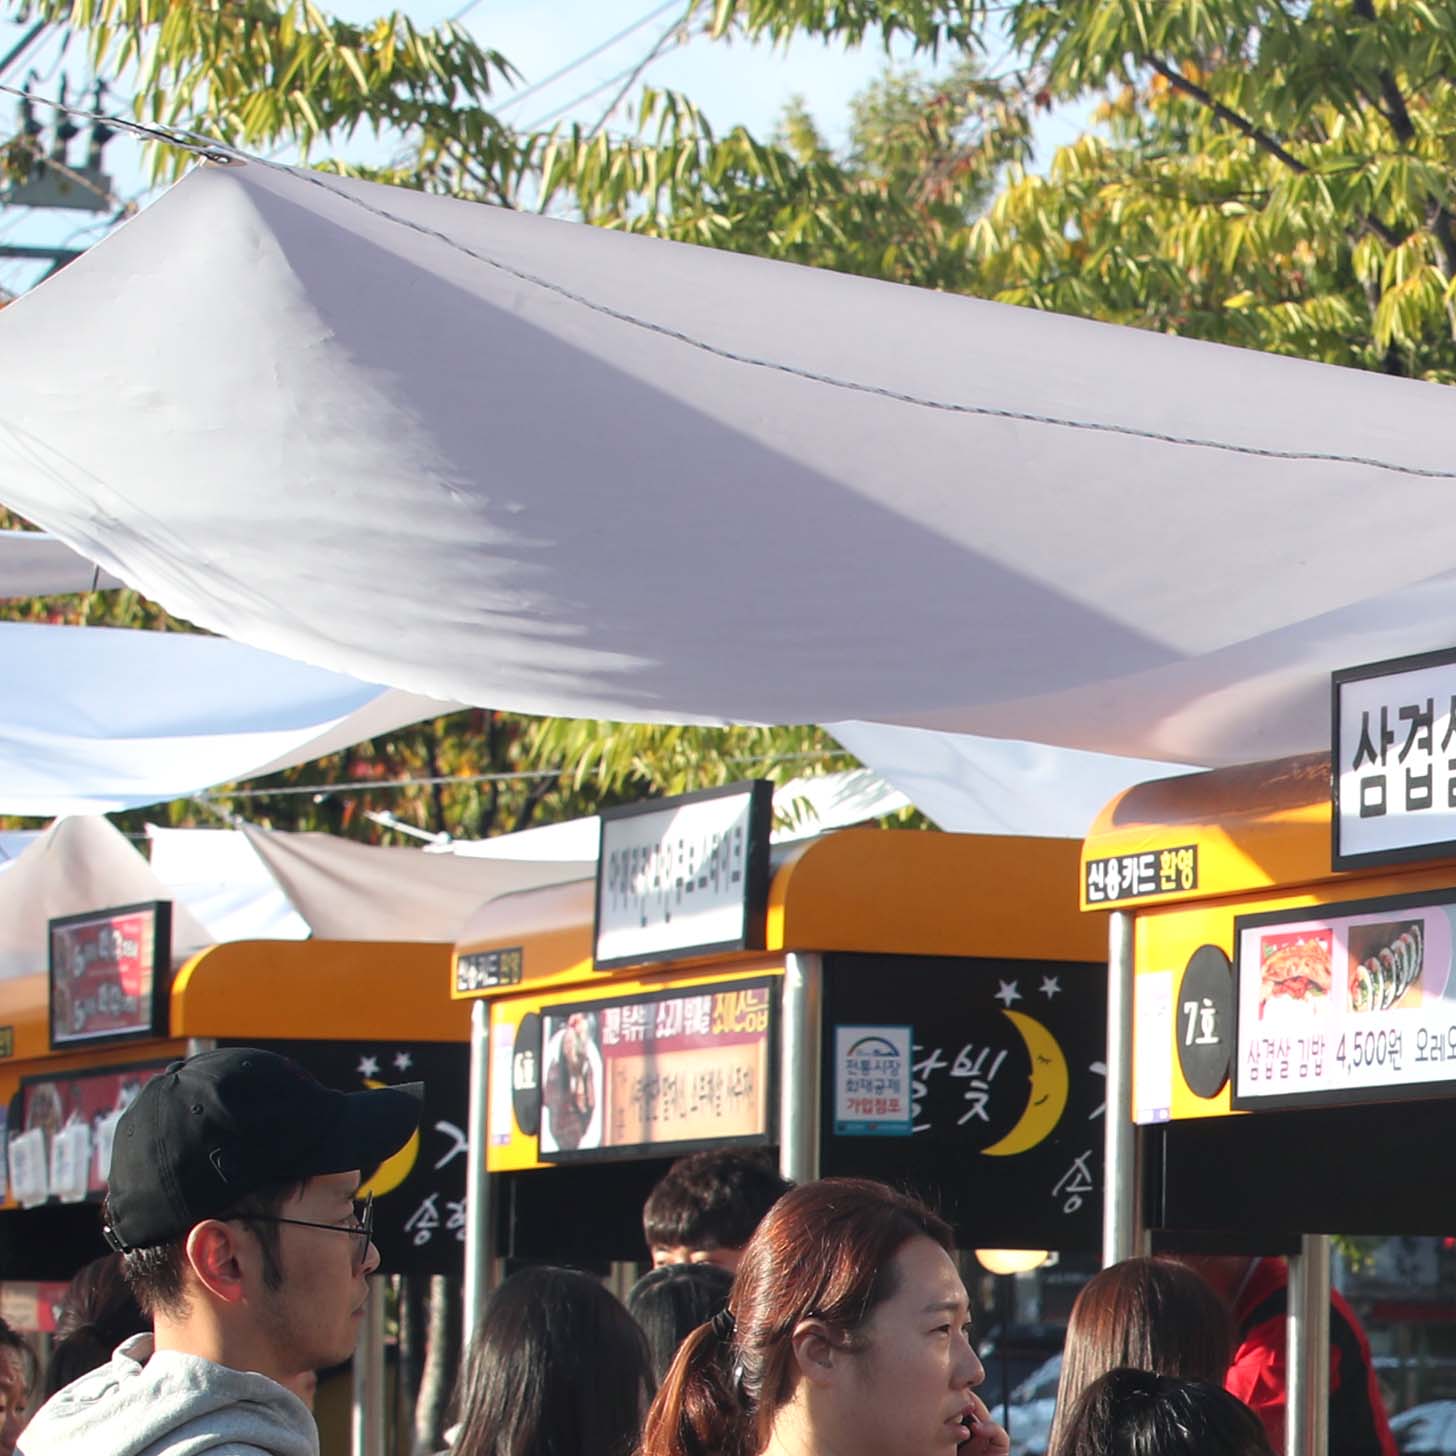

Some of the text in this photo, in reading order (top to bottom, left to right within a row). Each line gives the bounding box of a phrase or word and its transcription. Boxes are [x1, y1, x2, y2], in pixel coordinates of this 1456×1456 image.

[1088, 848, 1194, 900] 신용카드 환영
[1184, 998, 1220, 1046] 7호
[1248, 1036, 1291, 1081] 삼겹살
[1298, 1033, 1326, 1078] 김밥
[1336, 1028, 1403, 1075] 4,500원
